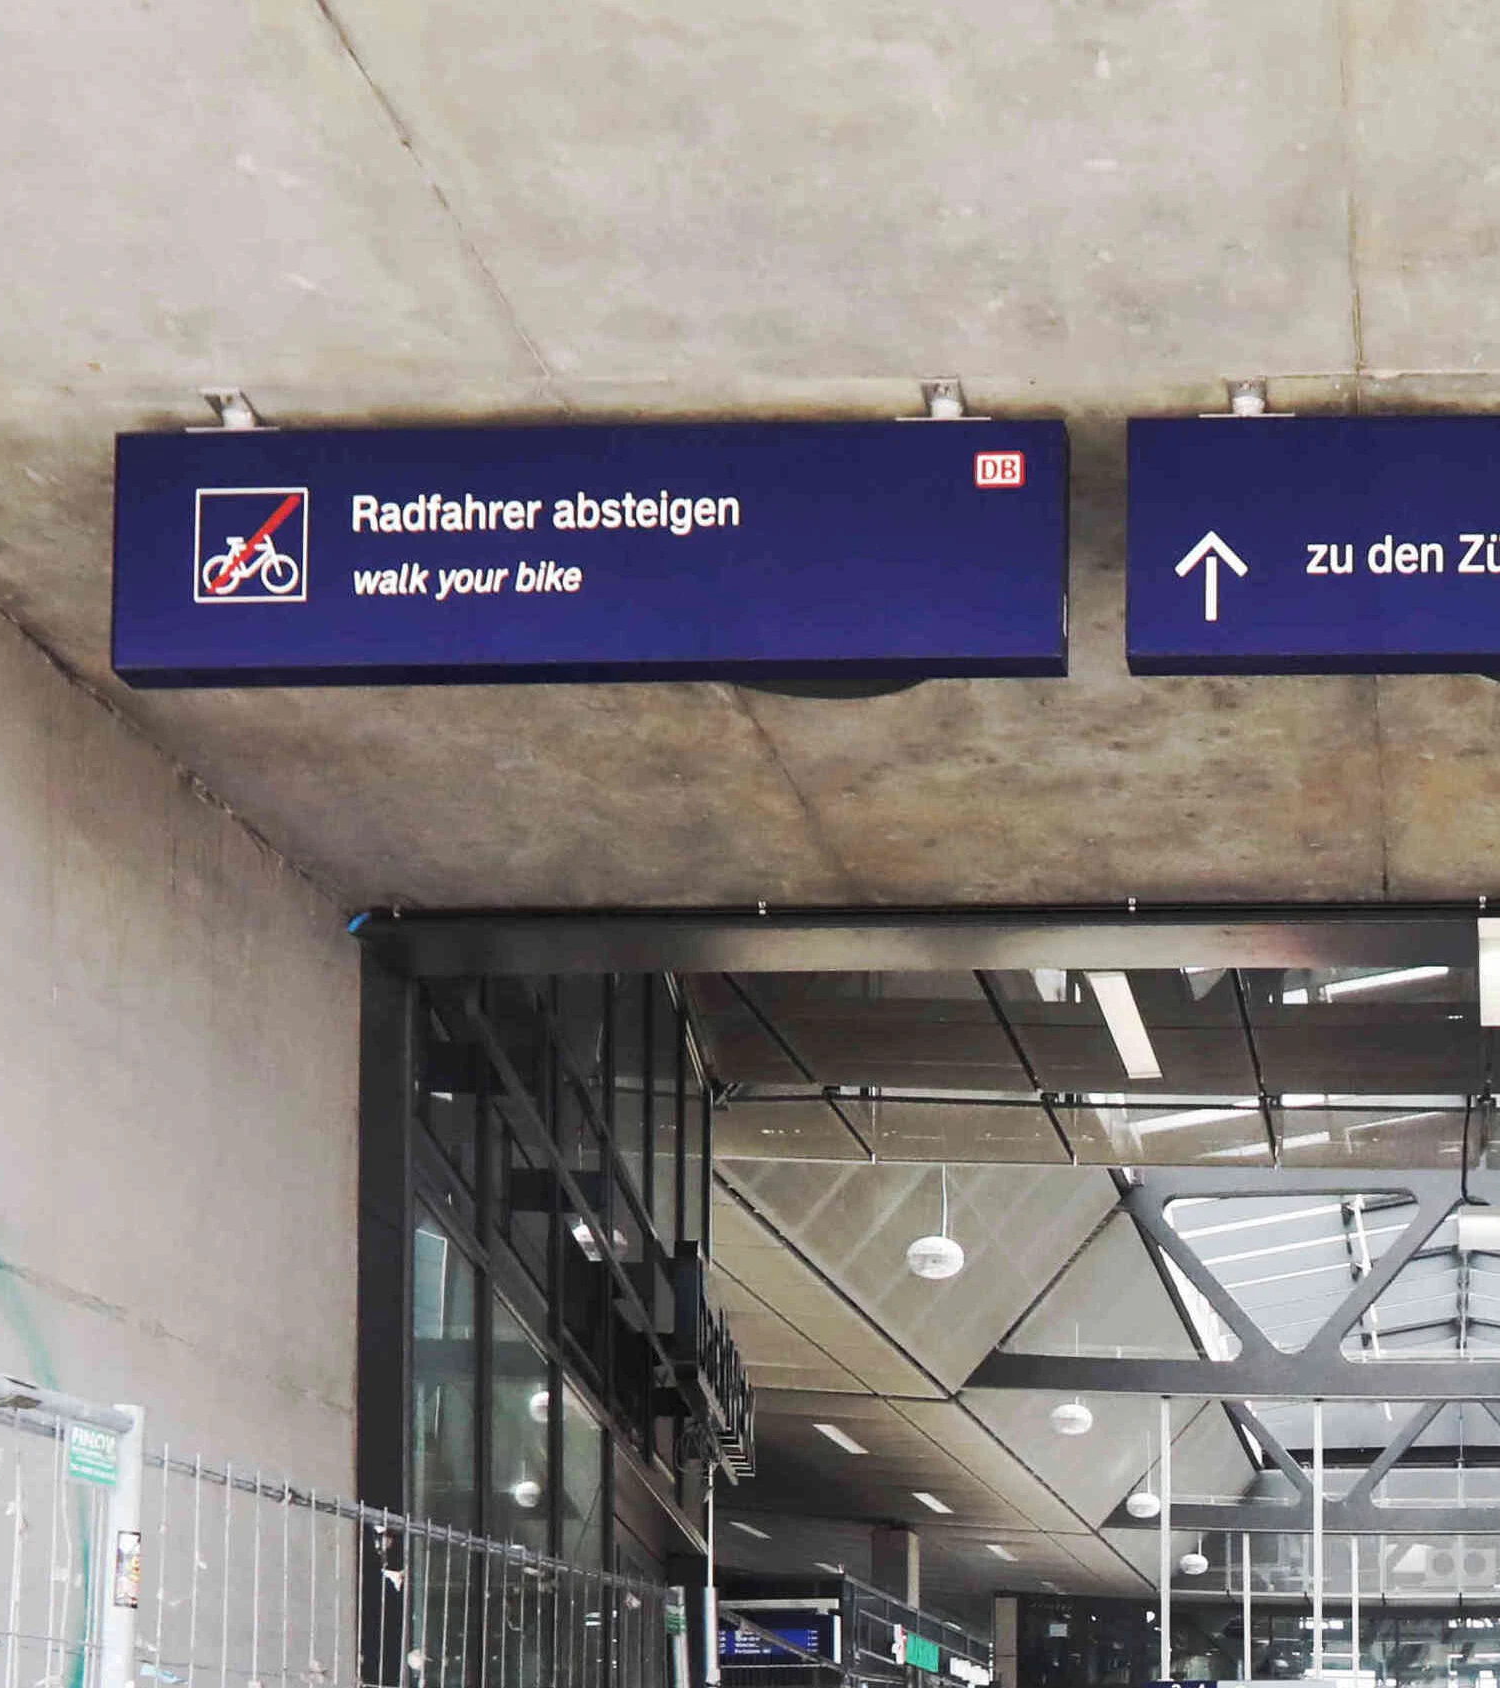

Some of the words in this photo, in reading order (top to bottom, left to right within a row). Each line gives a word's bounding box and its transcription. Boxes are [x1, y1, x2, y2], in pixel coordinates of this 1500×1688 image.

[352, 493, 543, 533] Radfahrer
[552, 490, 740, 535] absteigen
[1306, 543, 1353, 575] zu
[1367, 534, 1444, 574] den
[353, 562, 430, 596] walk
[434, 567, 510, 601] your
[514, 560, 583, 593] bike
